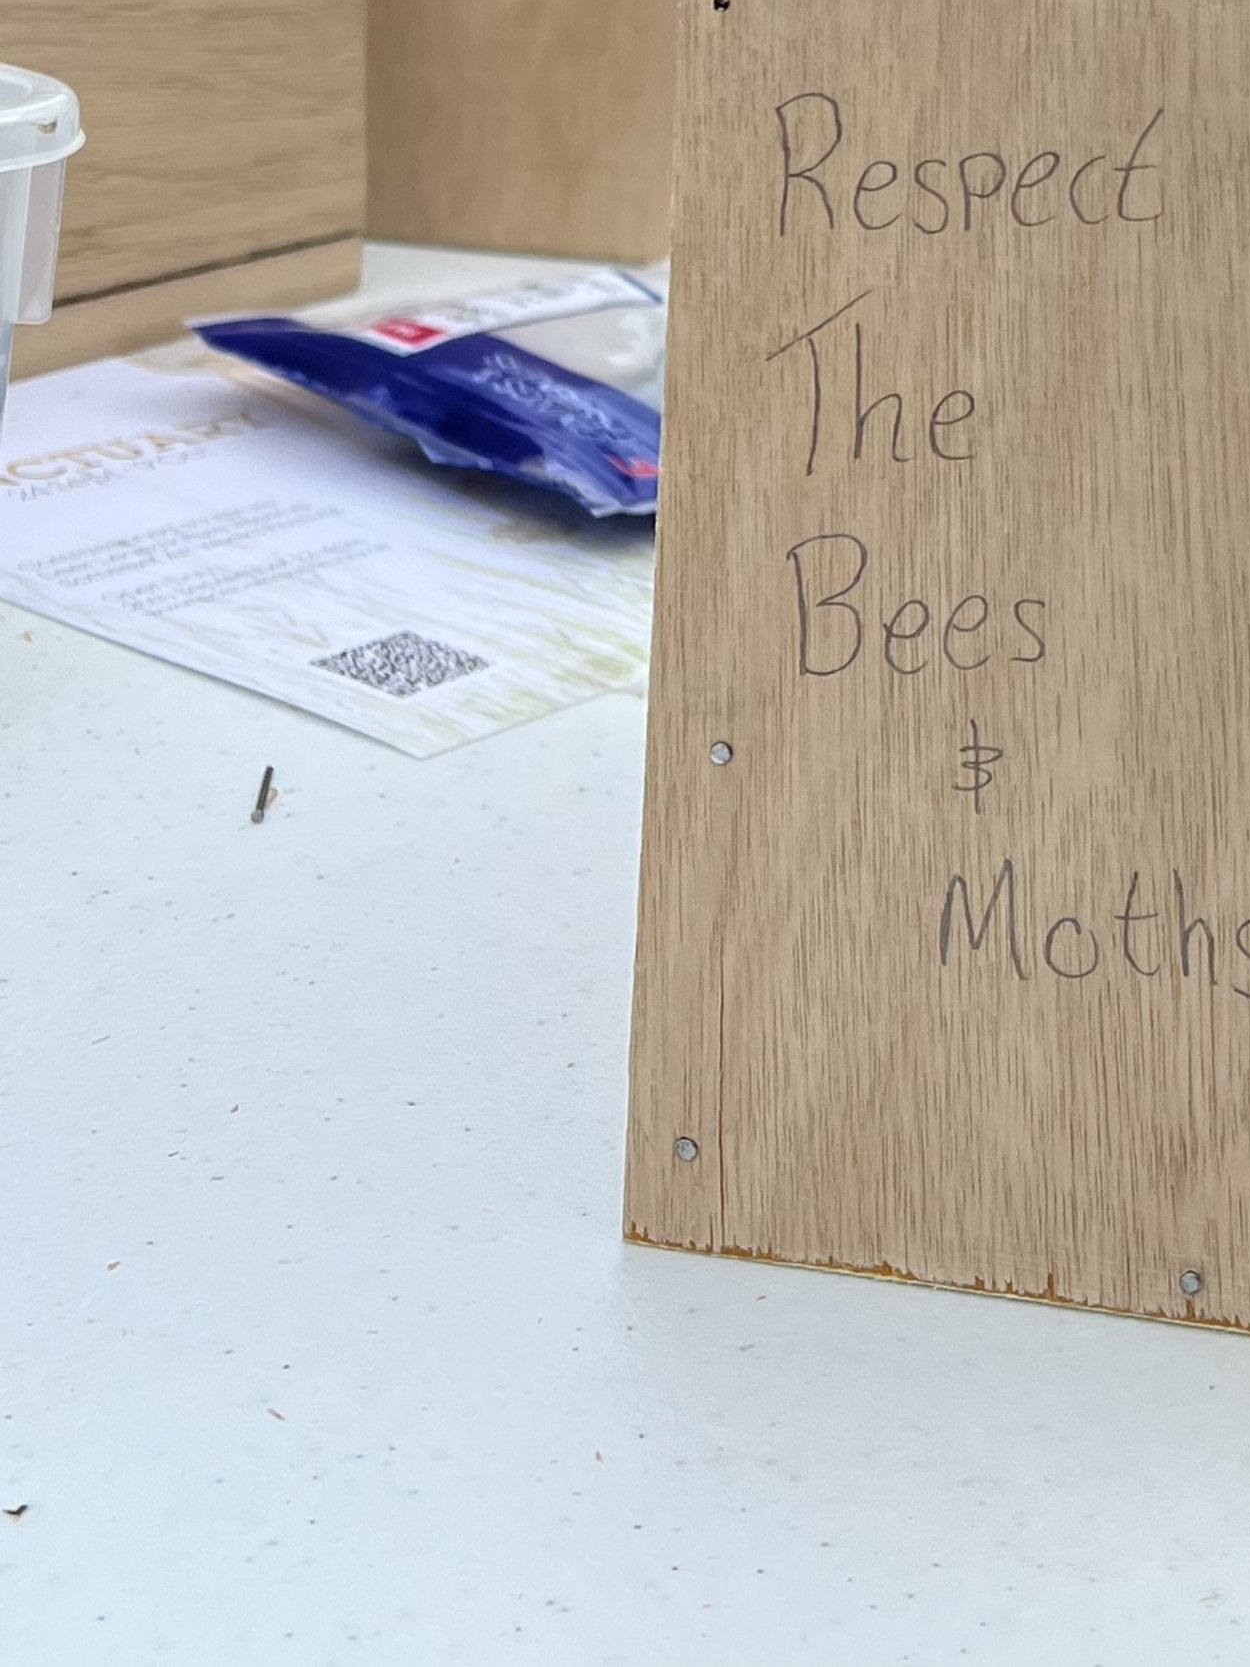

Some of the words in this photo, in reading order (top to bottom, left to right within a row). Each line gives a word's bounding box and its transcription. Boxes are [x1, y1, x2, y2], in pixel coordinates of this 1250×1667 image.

[775, 91, 1165, 237] Respect
[764, 288, 978, 477] The
[785, 534, 1047, 676] Bees
[951, 718, 1003, 814] &
